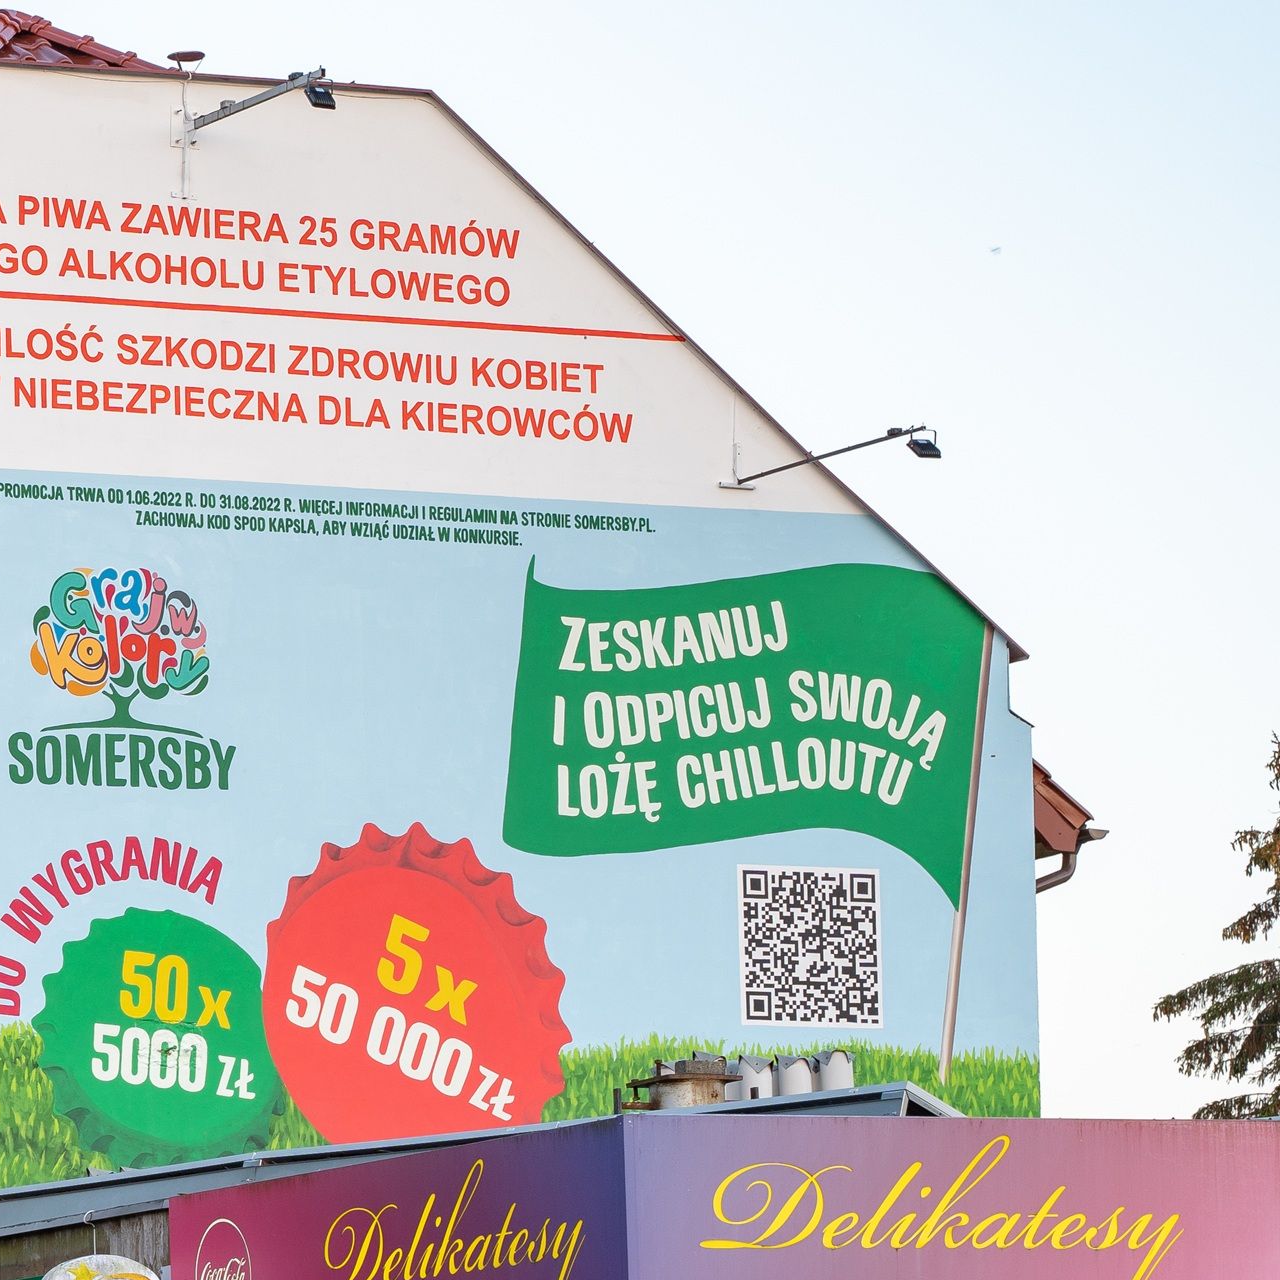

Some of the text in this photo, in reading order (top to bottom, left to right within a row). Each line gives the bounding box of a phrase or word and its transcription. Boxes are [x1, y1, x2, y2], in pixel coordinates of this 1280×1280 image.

[18, 195, 111, 231] PIWA
[120, 202, 288, 244] ZAWIERA
[299, 216, 337, 247] 25
[350, 219, 520, 259] GRAMÓW
[59, 248, 264, 291] ALKOHOLU
[279, 263, 510, 307] ETYLOWEGO
[117, 334, 275, 373] SZKODZI
[288, 345, 457, 385] ZDROWIU
[472, 357, 604, 394] KOBIET
[14, 377, 306, 423] NIEBEZPIECZNA
[319, 395, 390, 429] DLA
[402, 401, 632, 443] KIEROWCÓW
[66, 486, 106, 503] TRWA
[107, 488, 124, 505] OD
[126, 489, 183, 507] 1.06.2022
[185, 492, 197, 508] R.
[200, 493, 216, 509] DO
[219, 495, 281, 512] 31.08.2022
[283, 497, 296, 513] R.
[298, 499, 343, 517] WIĘCEJ
[345, 502, 419, 520] INFORMACJI
[421, 505, 427, 520] I
[428, 506, 498, 525] REGULAMIN
[499, 510, 519, 526] NA
[521, 511, 572, 529] STRONIE
[574, 514, 657, 533] SOMERSBY.PL.
[135, 510, 523, 546] ZACHOWAJ KOD SPOD KAPSLA, ABY WZIĄĆ UDZIAŁ W KONKURSIE.
[558, 600, 789, 672] ZESKANUJ
[552, 670, 947, 771] I ODPICUJ SWOJĄ
[7, 731, 237, 790] SOMERSBY
[556, 737, 914, 823] LOŻĘ CHILLOUTU
[0, 836, 223, 944] WYGRANIA
[119, 950, 189, 1022] 50
[376, 913, 430, 996] 5
[91, 1023, 208, 1093] 5000
[285, 964, 359, 1045] 50
[365, 1003, 474, 1098] 000
